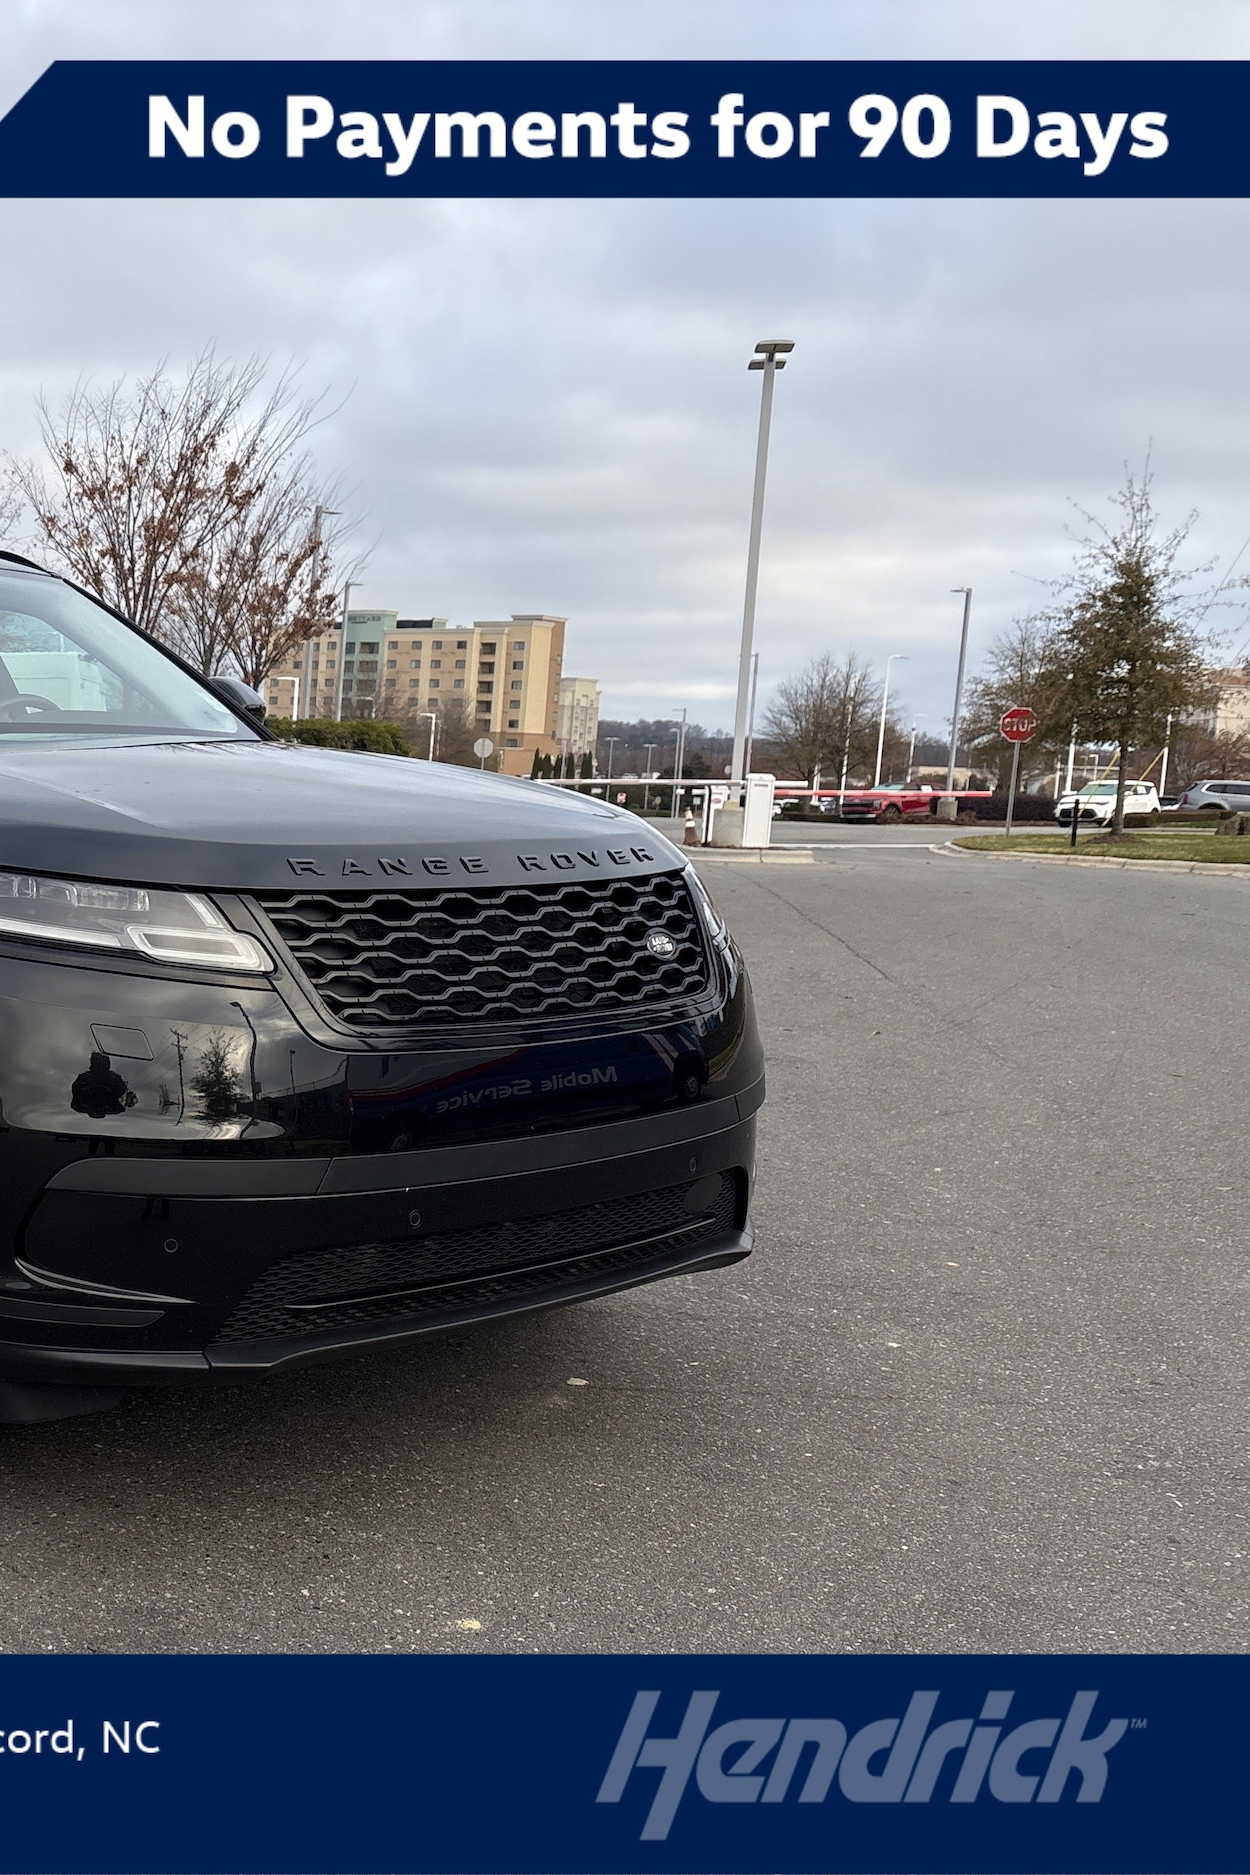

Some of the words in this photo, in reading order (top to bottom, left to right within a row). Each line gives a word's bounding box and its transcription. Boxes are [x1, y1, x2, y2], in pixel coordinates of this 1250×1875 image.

[1004, 718, 1038, 731] STOP
[287, 856, 489, 877] RANGE
[517, 847, 655, 872] ROVER
